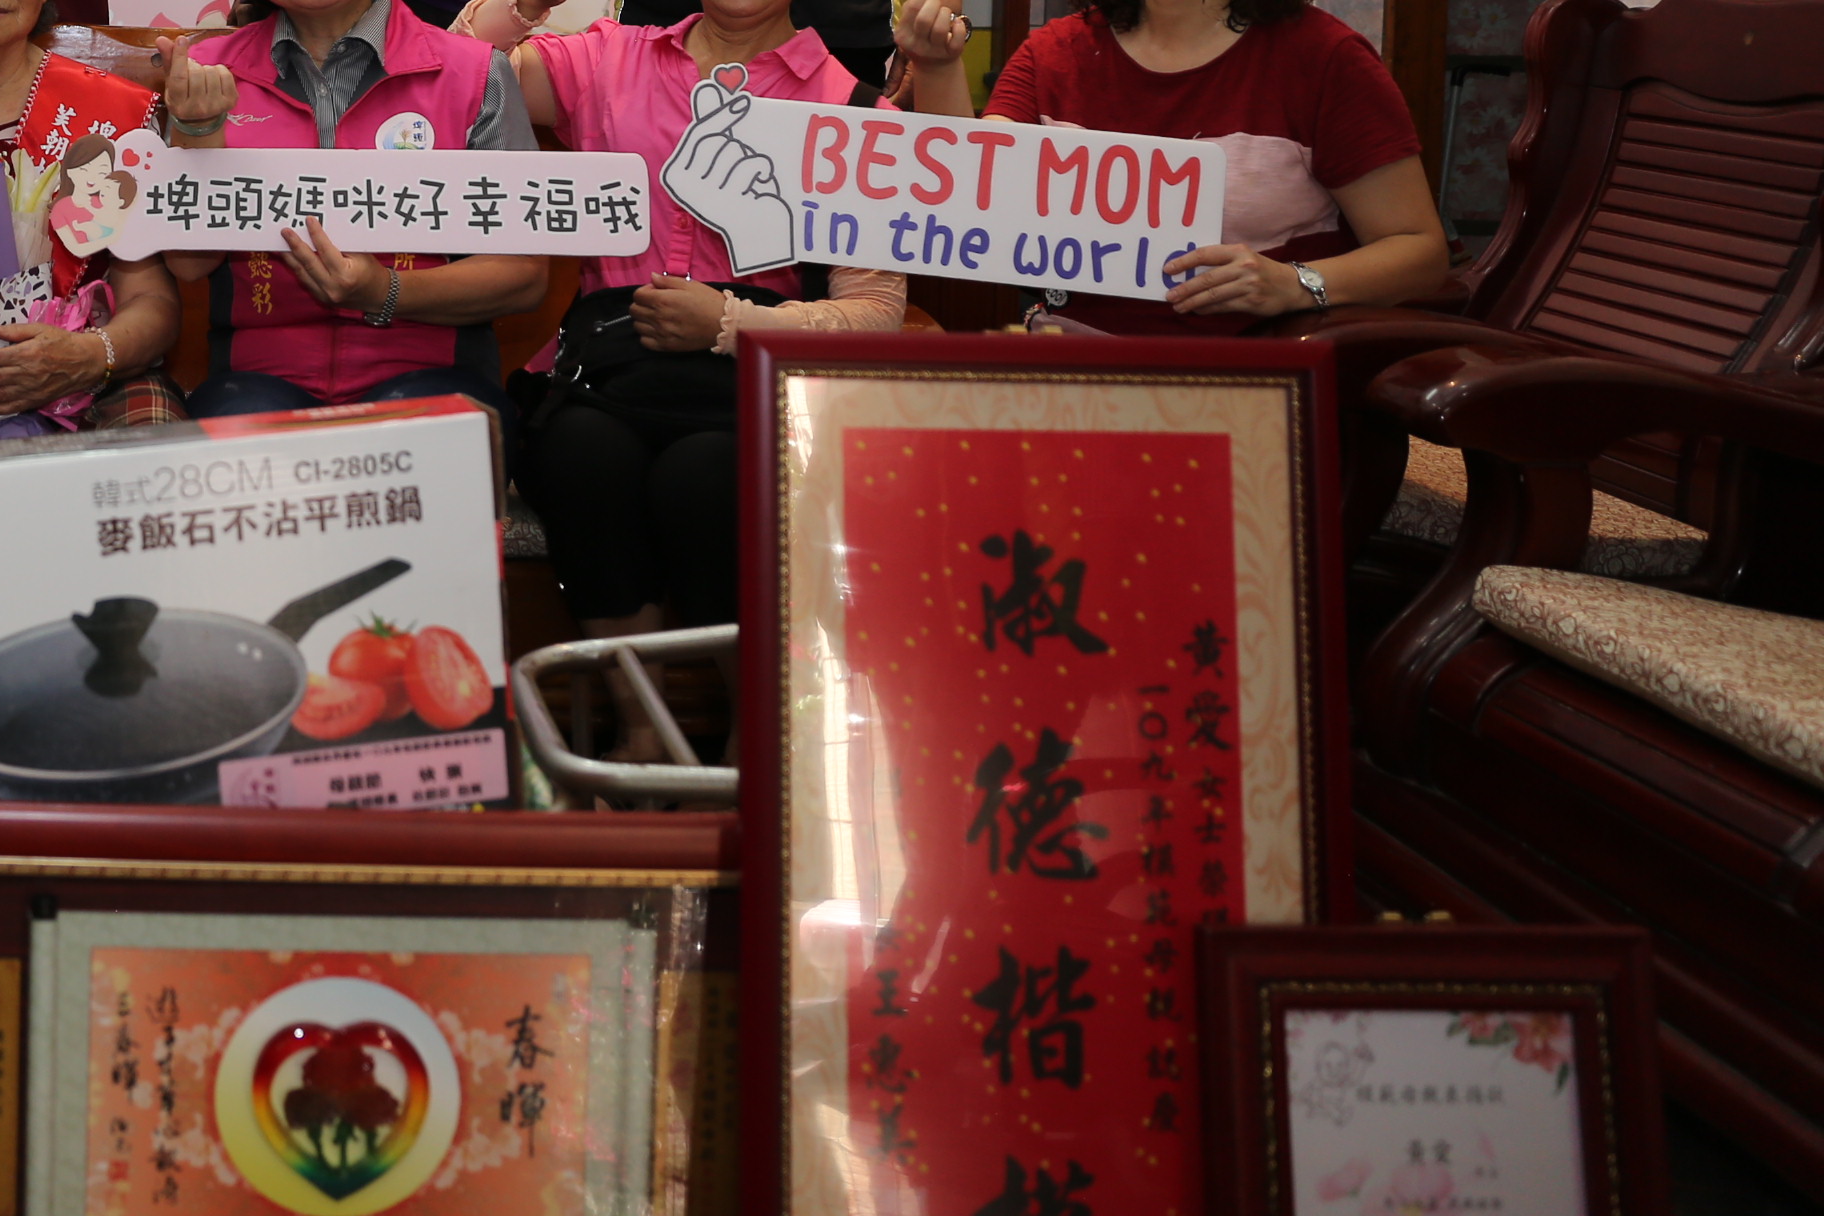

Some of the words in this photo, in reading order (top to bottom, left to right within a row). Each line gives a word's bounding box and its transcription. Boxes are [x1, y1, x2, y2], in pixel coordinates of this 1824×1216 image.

[37, 102, 77, 172] 芙朝
[799, 112, 1016, 212] BEST
[1036, 135, 1202, 230] MOM
[145, 173, 644, 235] 埤頭媽咪好幸福哦
[800, 200, 860, 257] in
[889, 211, 991, 270] the
[1013, 230, 1197, 291] world
[91, 456, 274, 507] 韓式28CM
[293, 450, 414, 485] CI-2805C
[95, 485, 423, 559] 麥飯石不沾平煎鍋
